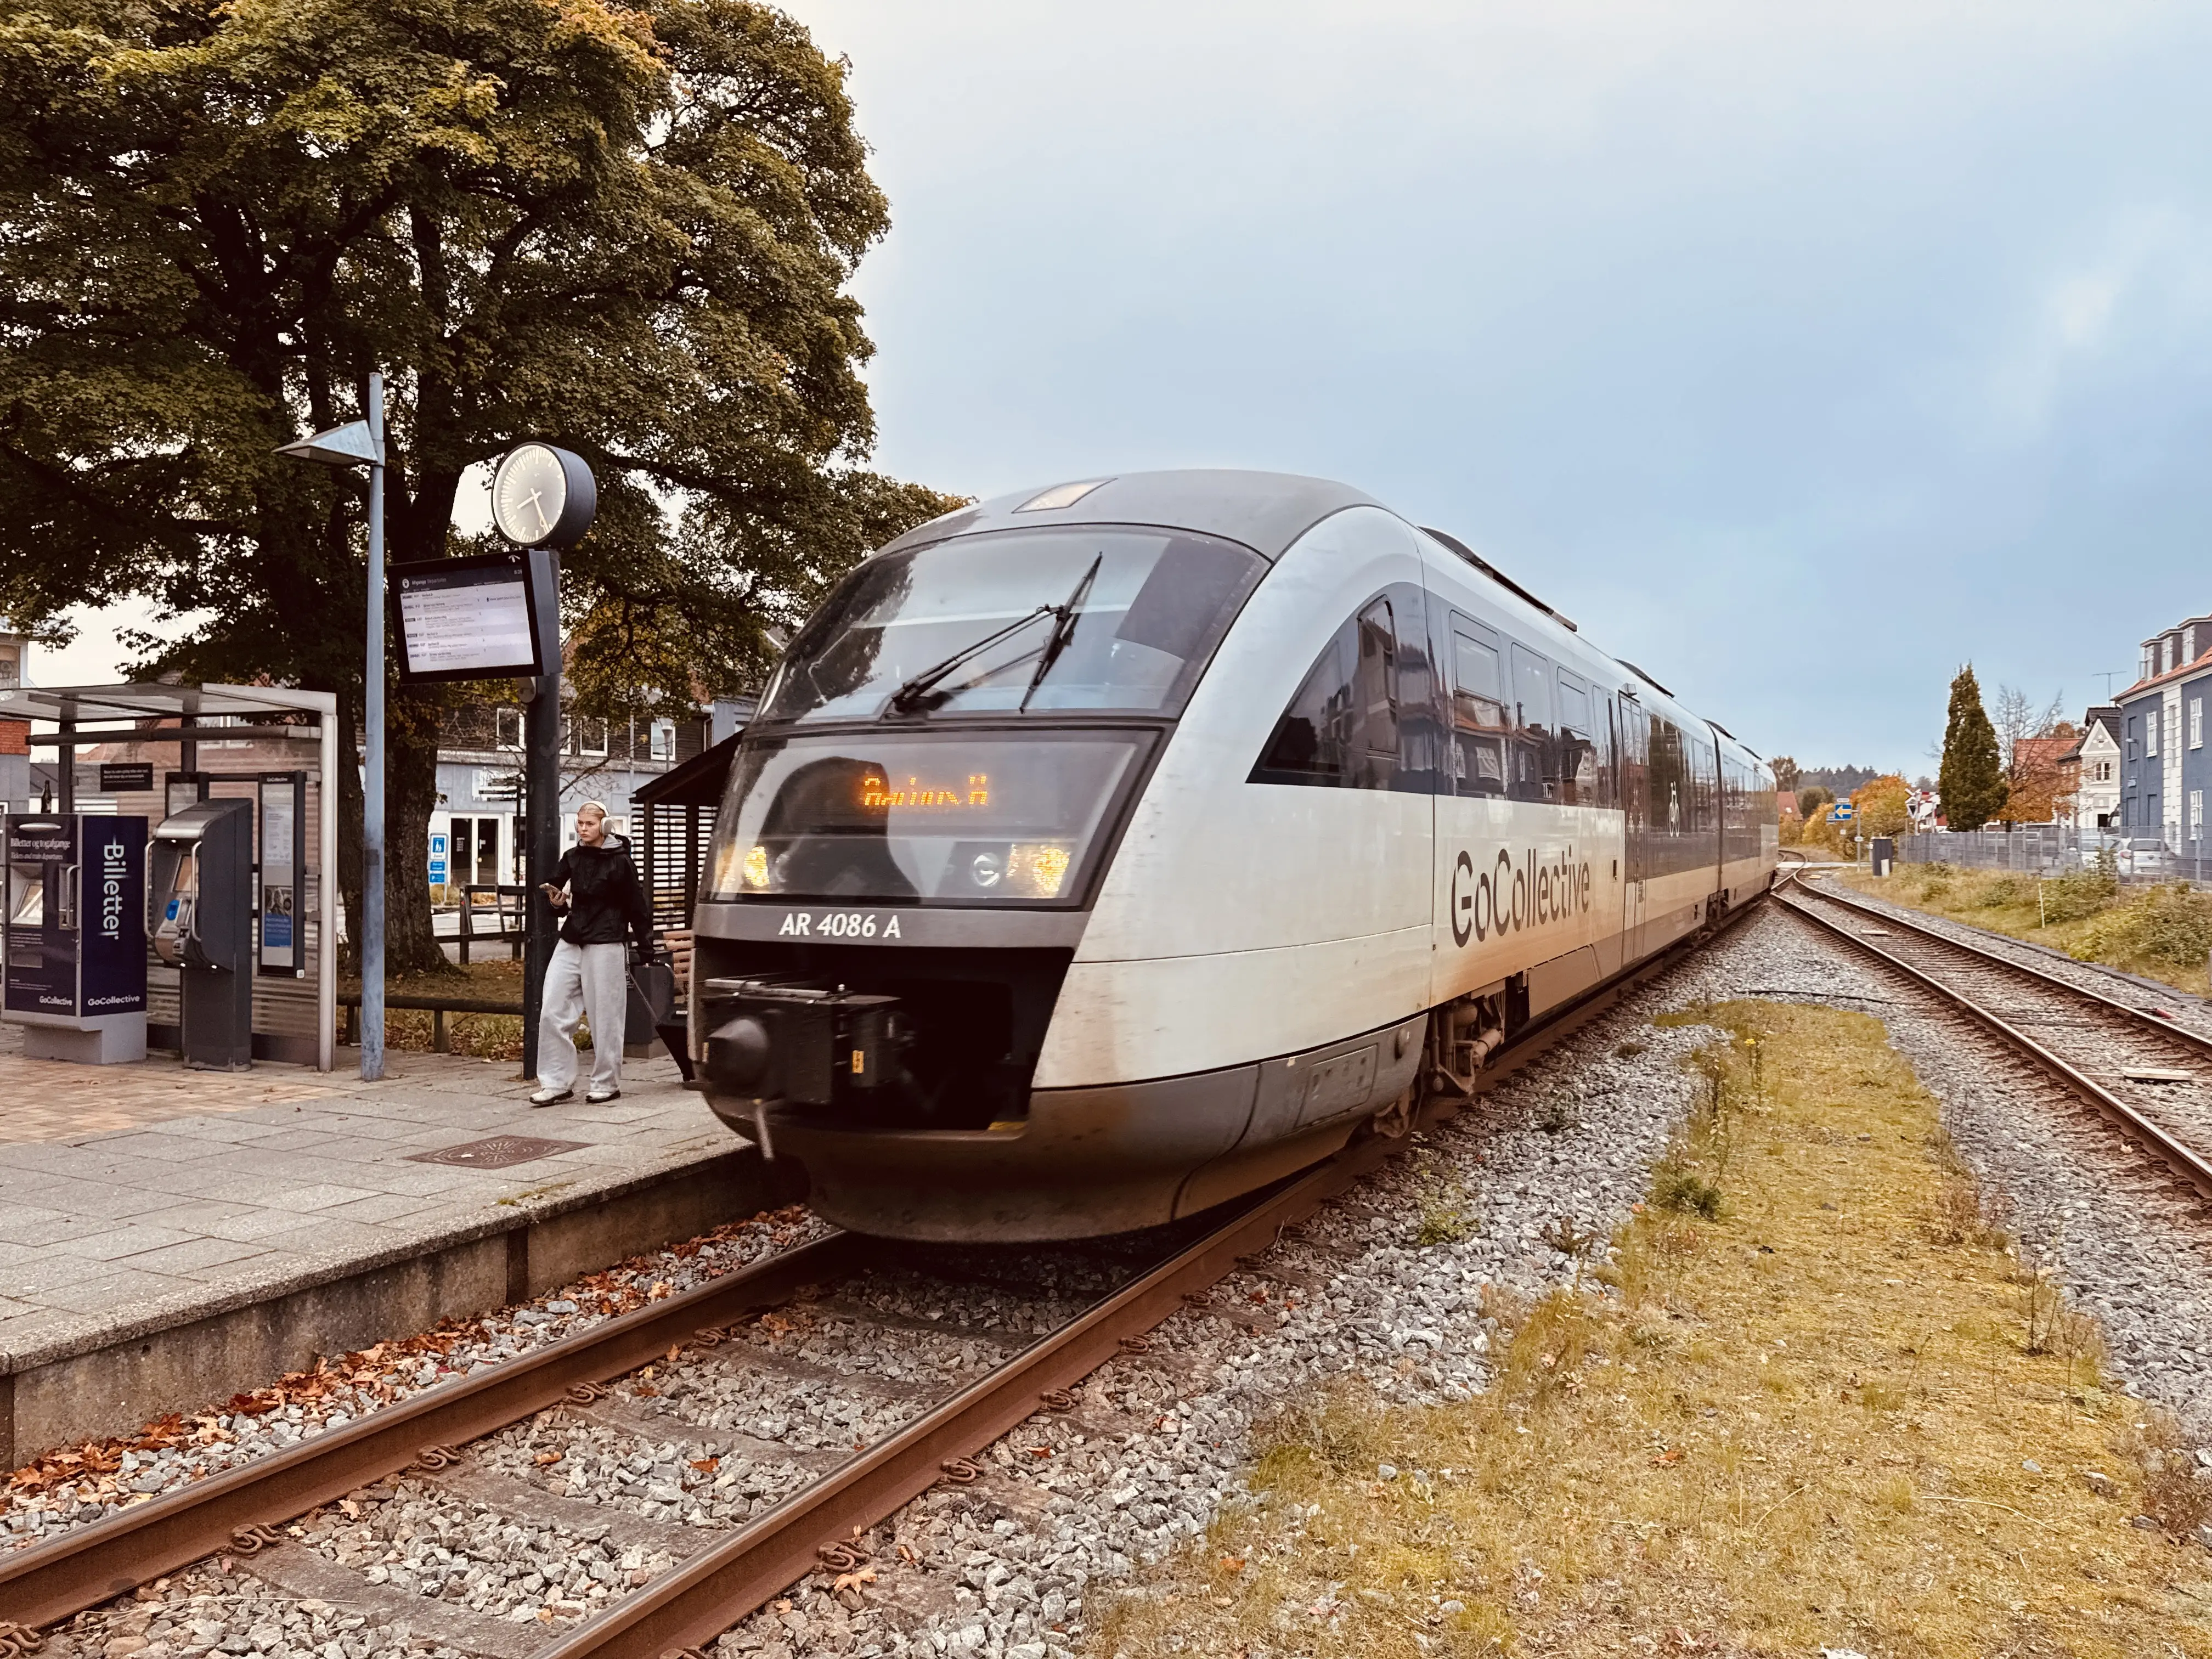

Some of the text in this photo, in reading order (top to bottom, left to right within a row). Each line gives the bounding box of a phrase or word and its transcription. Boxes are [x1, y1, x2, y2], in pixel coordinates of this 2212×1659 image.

[102, 836, 129, 940] Billetter
[1451, 844, 1590, 948] GoCollective
[778, 913, 901, 938] AR 4086 A
[39, 995, 72, 1006] GoCollective
[87, 995, 140, 1006] GoCollective
